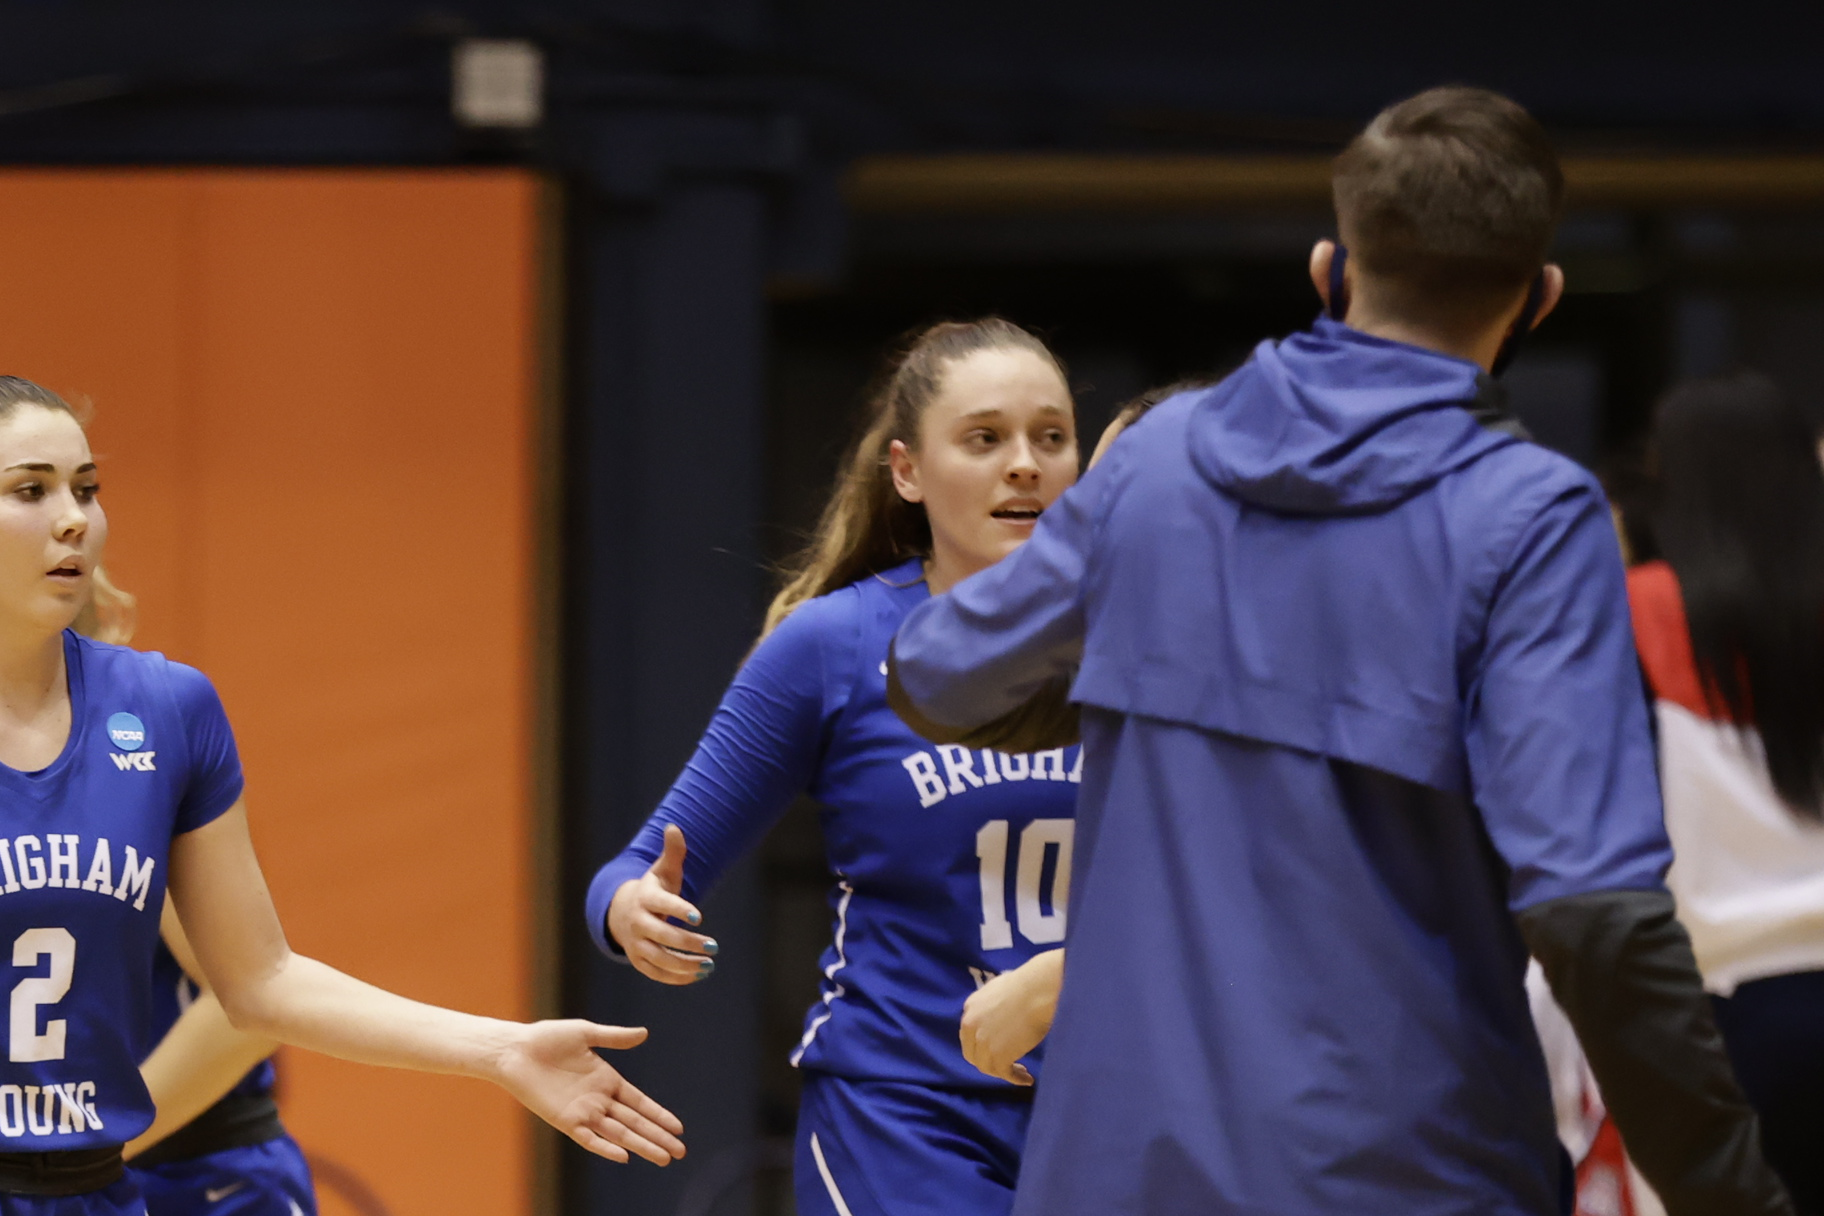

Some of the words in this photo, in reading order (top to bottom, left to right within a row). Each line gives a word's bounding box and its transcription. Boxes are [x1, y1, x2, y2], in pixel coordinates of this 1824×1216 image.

[108, 751, 156, 771] WCC
[112, 729, 145, 742] NCAA
[976, 818, 1075, 950] 10
[9, 927, 76, 1062] 2
